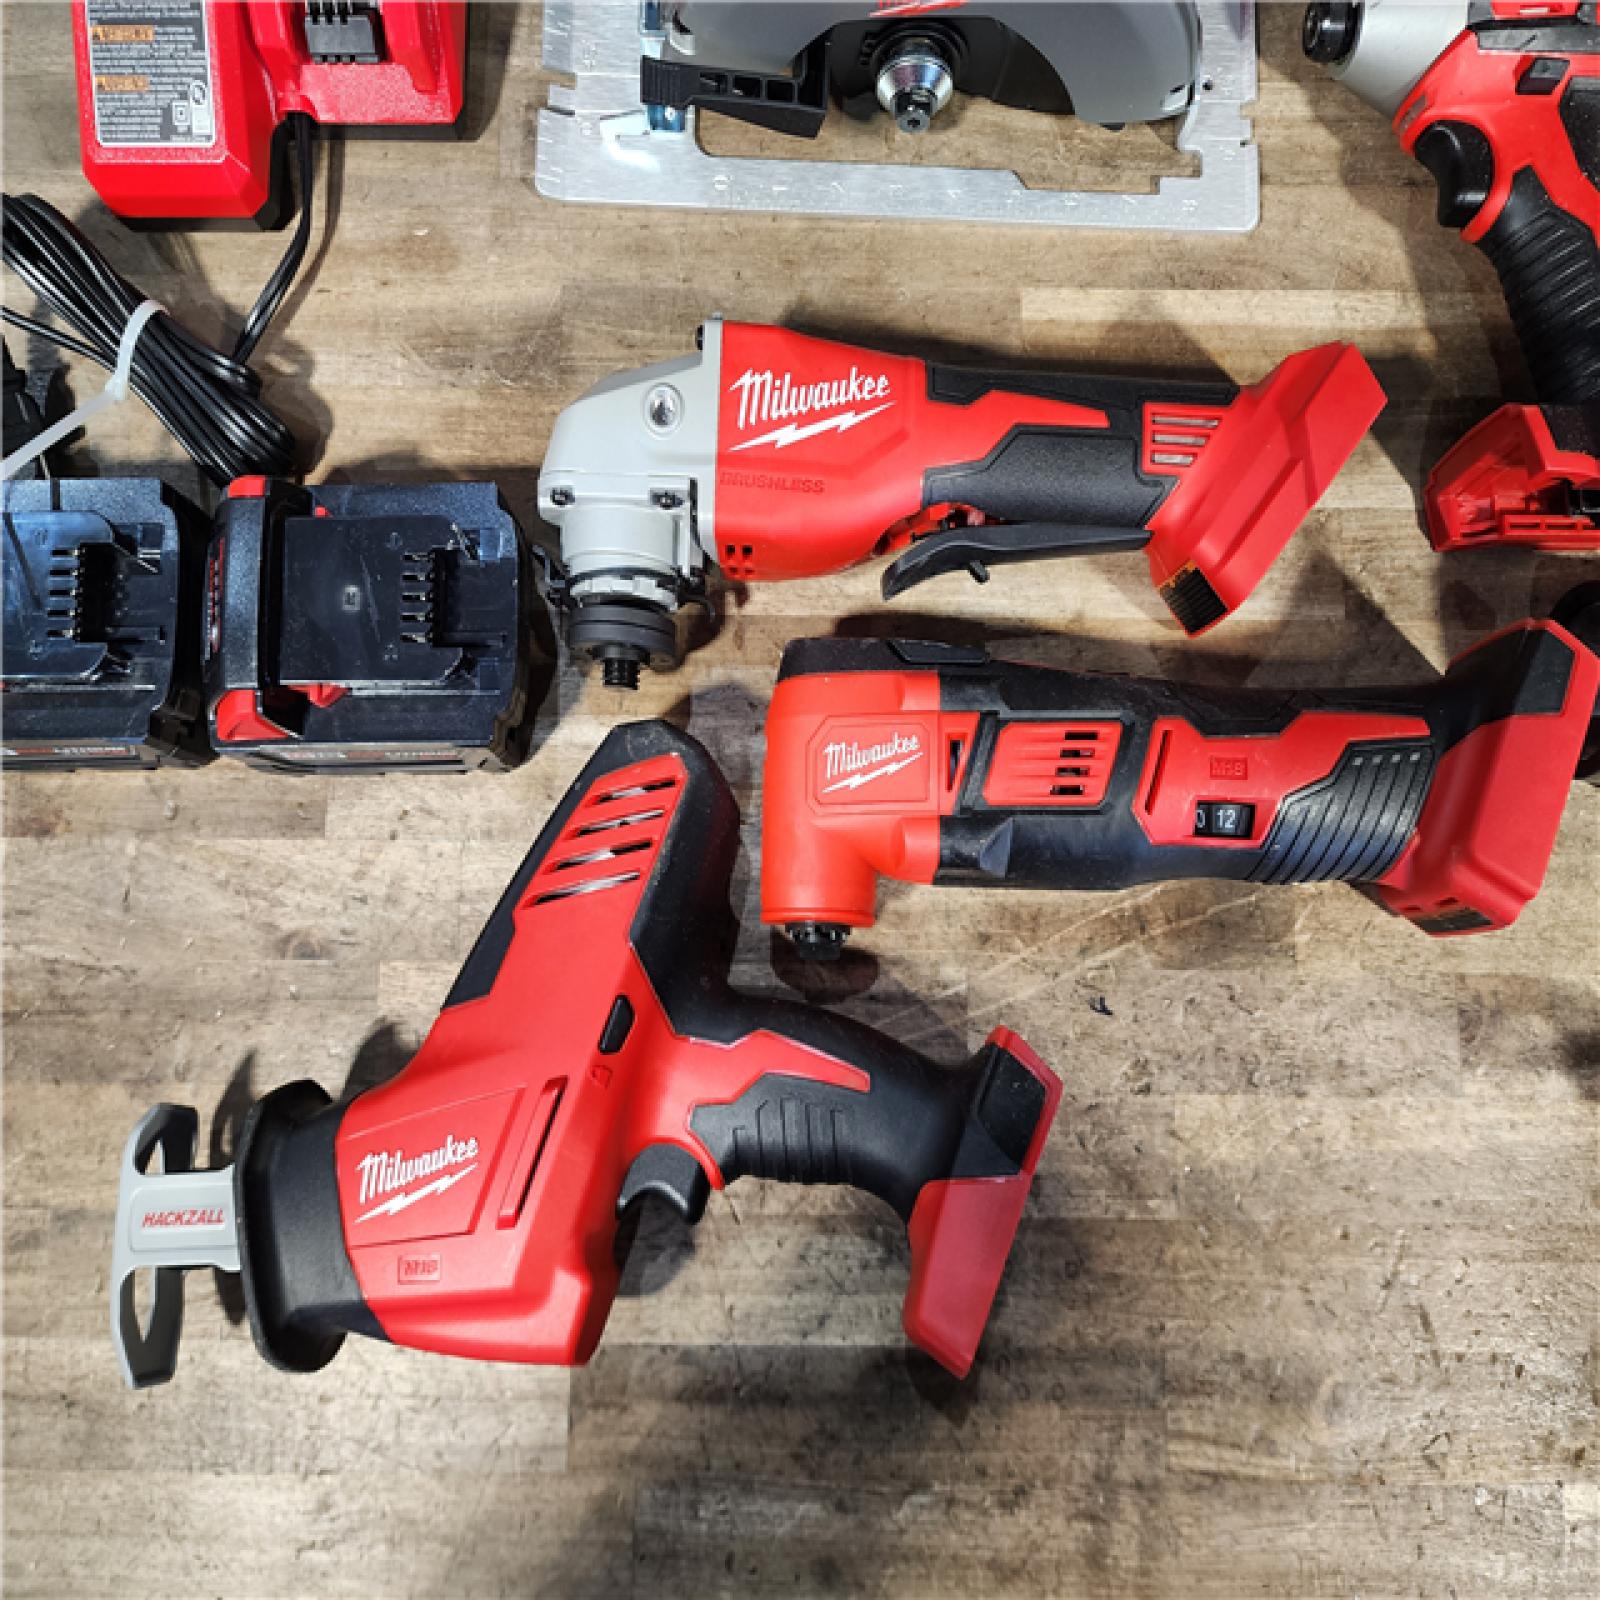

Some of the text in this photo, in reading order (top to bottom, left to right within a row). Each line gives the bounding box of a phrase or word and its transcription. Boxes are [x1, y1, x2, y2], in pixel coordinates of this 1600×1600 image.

[729, 365, 891, 430] Milwaukee
[824, 731, 920, 780] Milwaukee
[1217, 809, 1236, 828] 12
[356, 1134, 479, 1205] Milwaukee
[142, 1207, 224, 1228] HACKZALL
